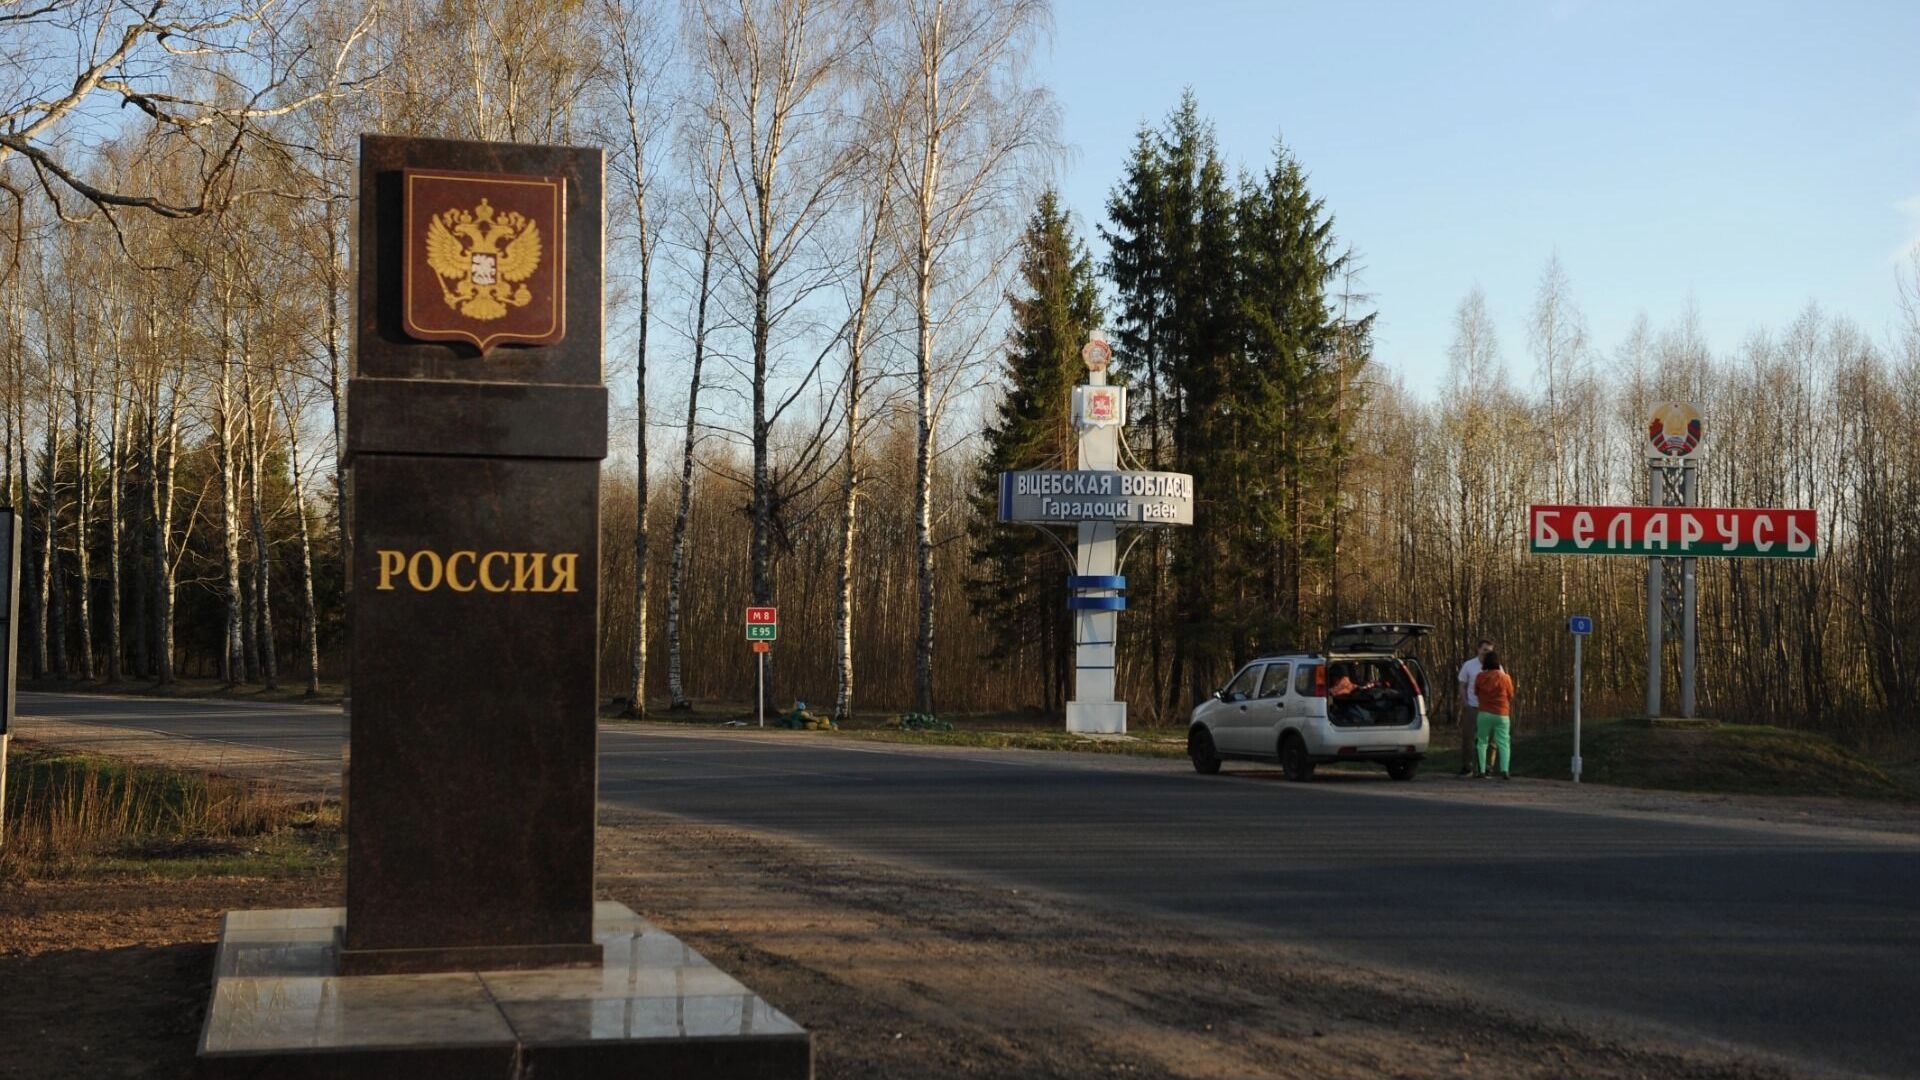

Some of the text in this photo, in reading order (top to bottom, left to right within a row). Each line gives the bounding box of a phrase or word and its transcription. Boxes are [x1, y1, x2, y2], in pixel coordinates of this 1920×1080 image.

[1018, 474, 1112, 498] ВІЦЕБСКАЯ
[1042, 497, 1177, 520] Гарадоцкі раён
[376, 550, 579, 592] РОССИЯ
[763, 611, 770, 620] 8
[759, 627, 771, 636] 95
